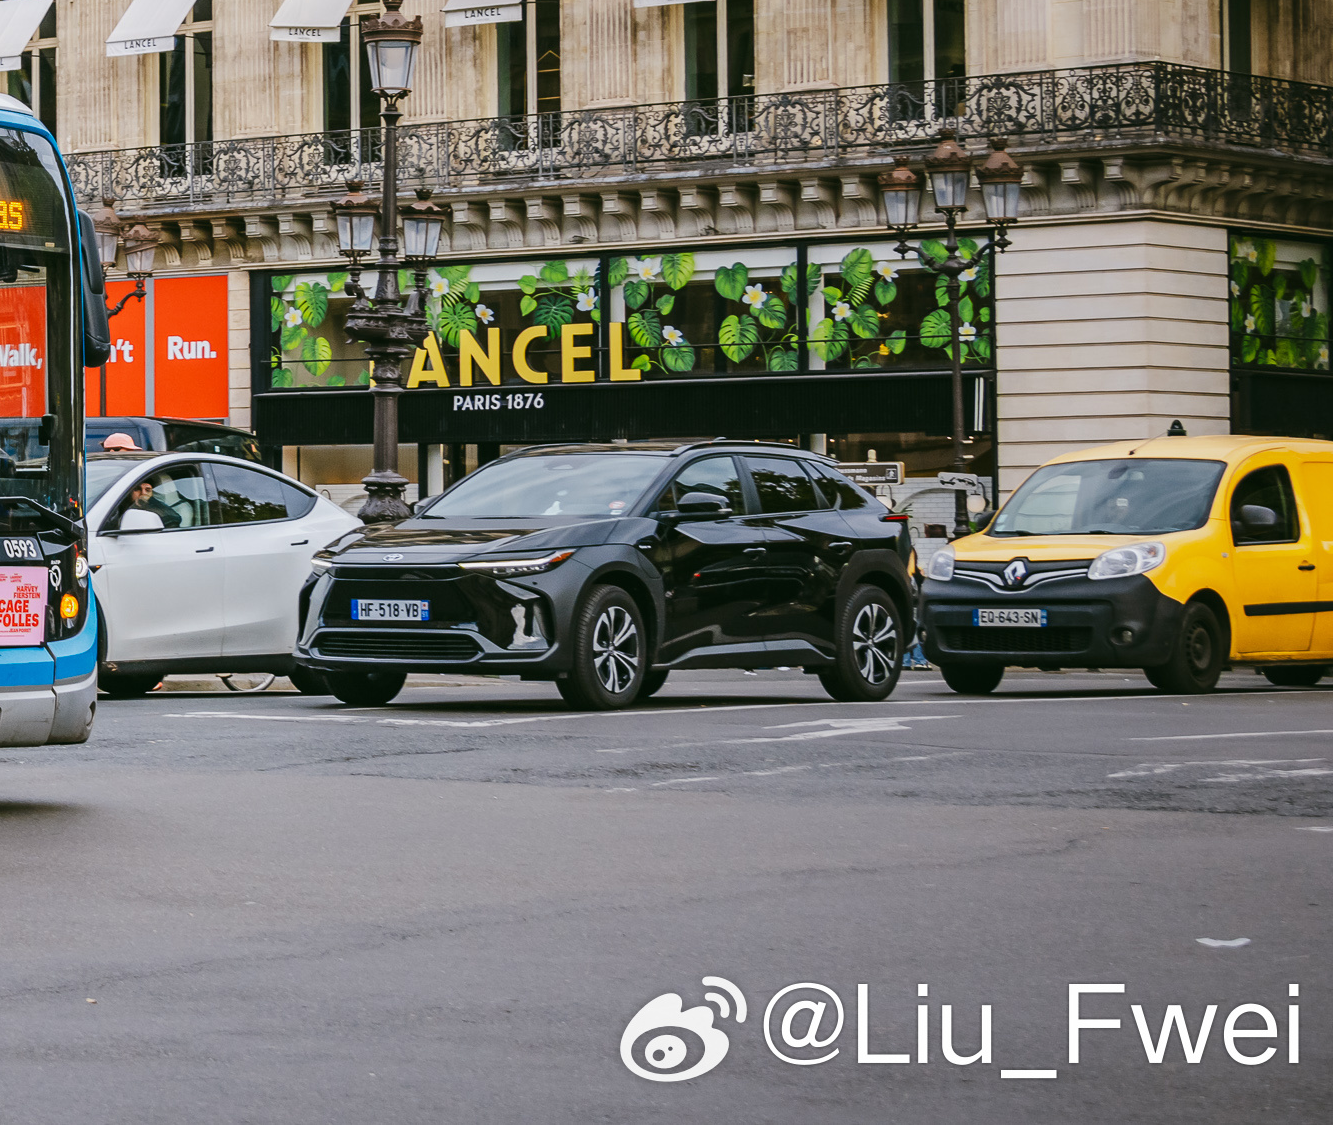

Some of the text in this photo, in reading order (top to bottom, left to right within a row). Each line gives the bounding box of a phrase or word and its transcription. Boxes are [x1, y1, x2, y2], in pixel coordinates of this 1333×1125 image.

[464, 8, 502, 20] LANCEL
[288, 27, 322, 38] LANCEL
[124, 38, 157, 50] LANCEL
[168, 336, 217, 360] Run.
[369, 322, 642, 388] ANCEL
[453, 393, 544, 410] PARIS 1876
[4, 540, 37, 558] 0593
[361, 603, 419, 617] HF-518-VB
[981, 611, 1038, 624] EQ-643-SN
